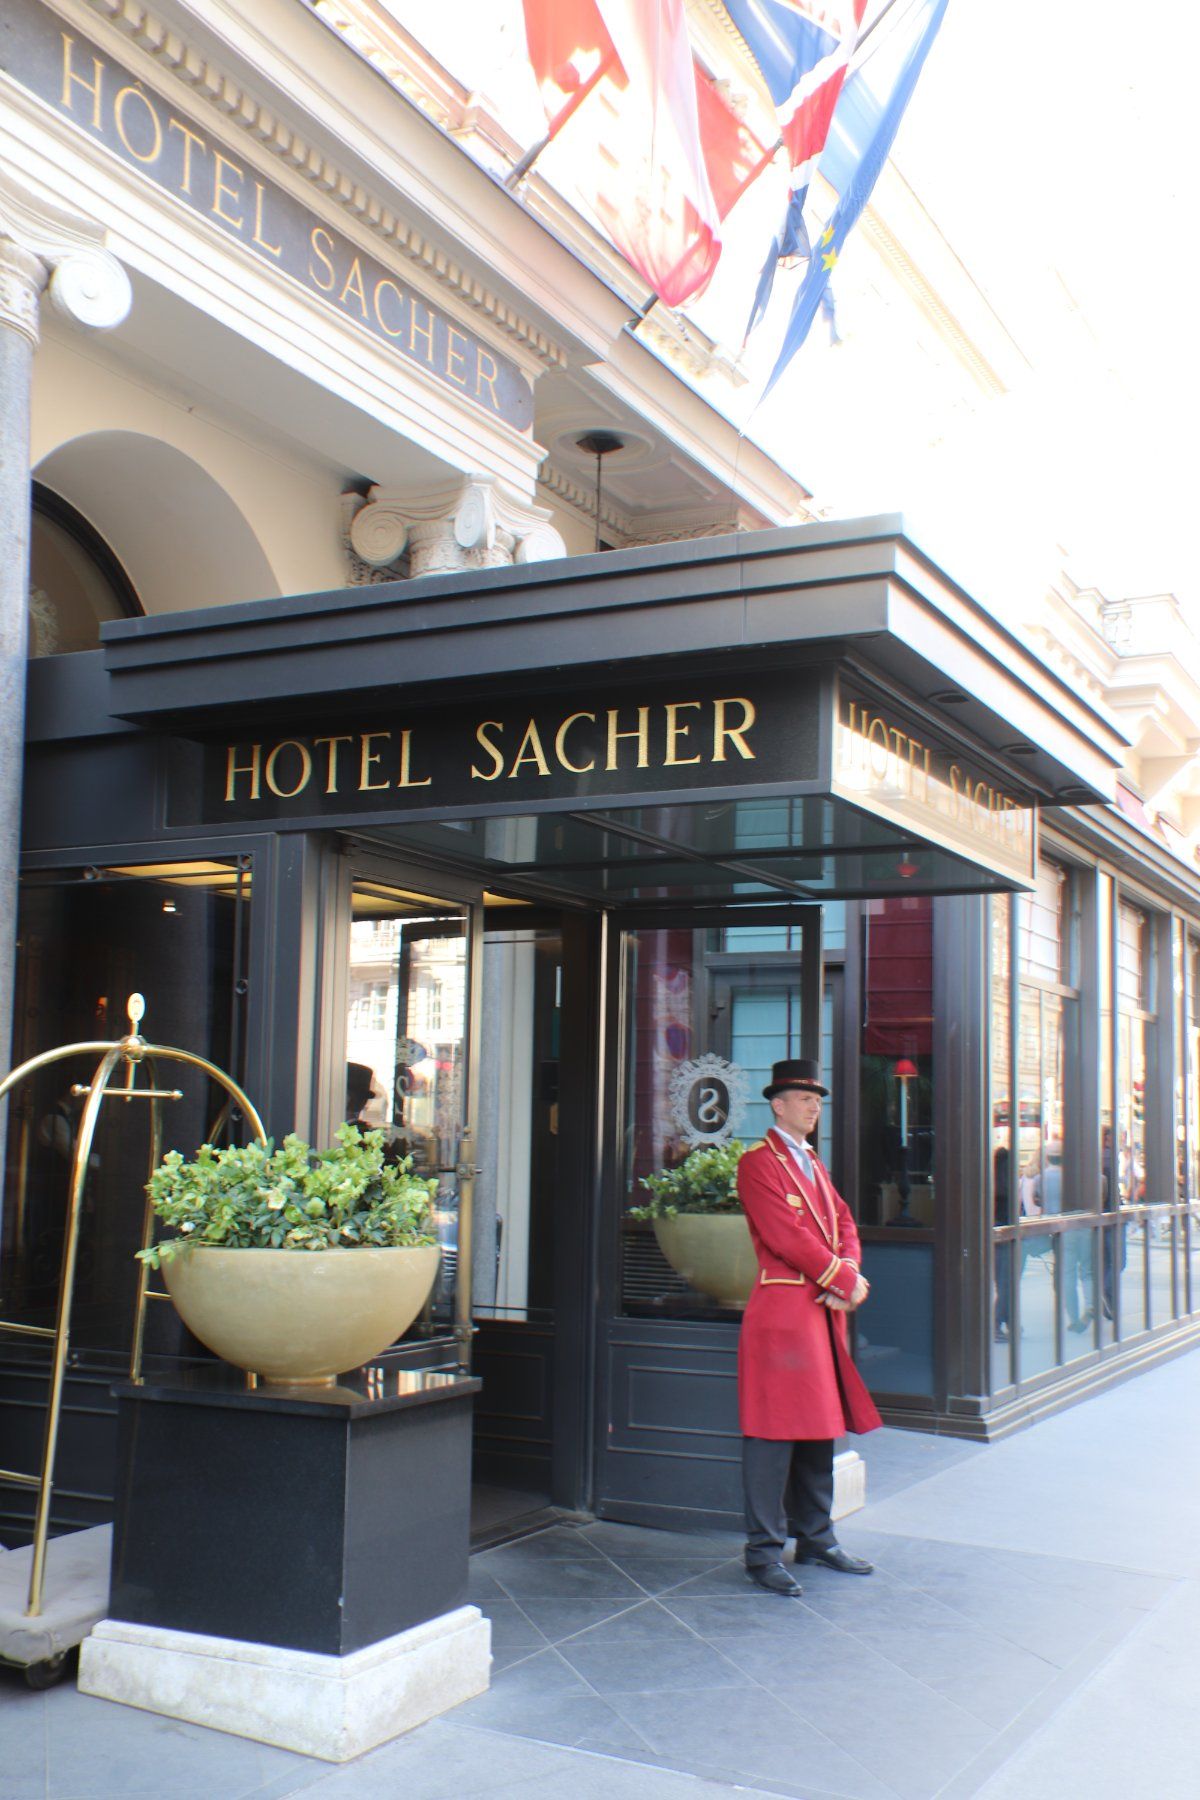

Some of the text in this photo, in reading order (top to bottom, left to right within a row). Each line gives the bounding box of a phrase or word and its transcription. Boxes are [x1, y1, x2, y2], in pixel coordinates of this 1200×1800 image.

[308, 226, 501, 409] SACHER
[224, 697, 756, 801] HOTEL SACHER
